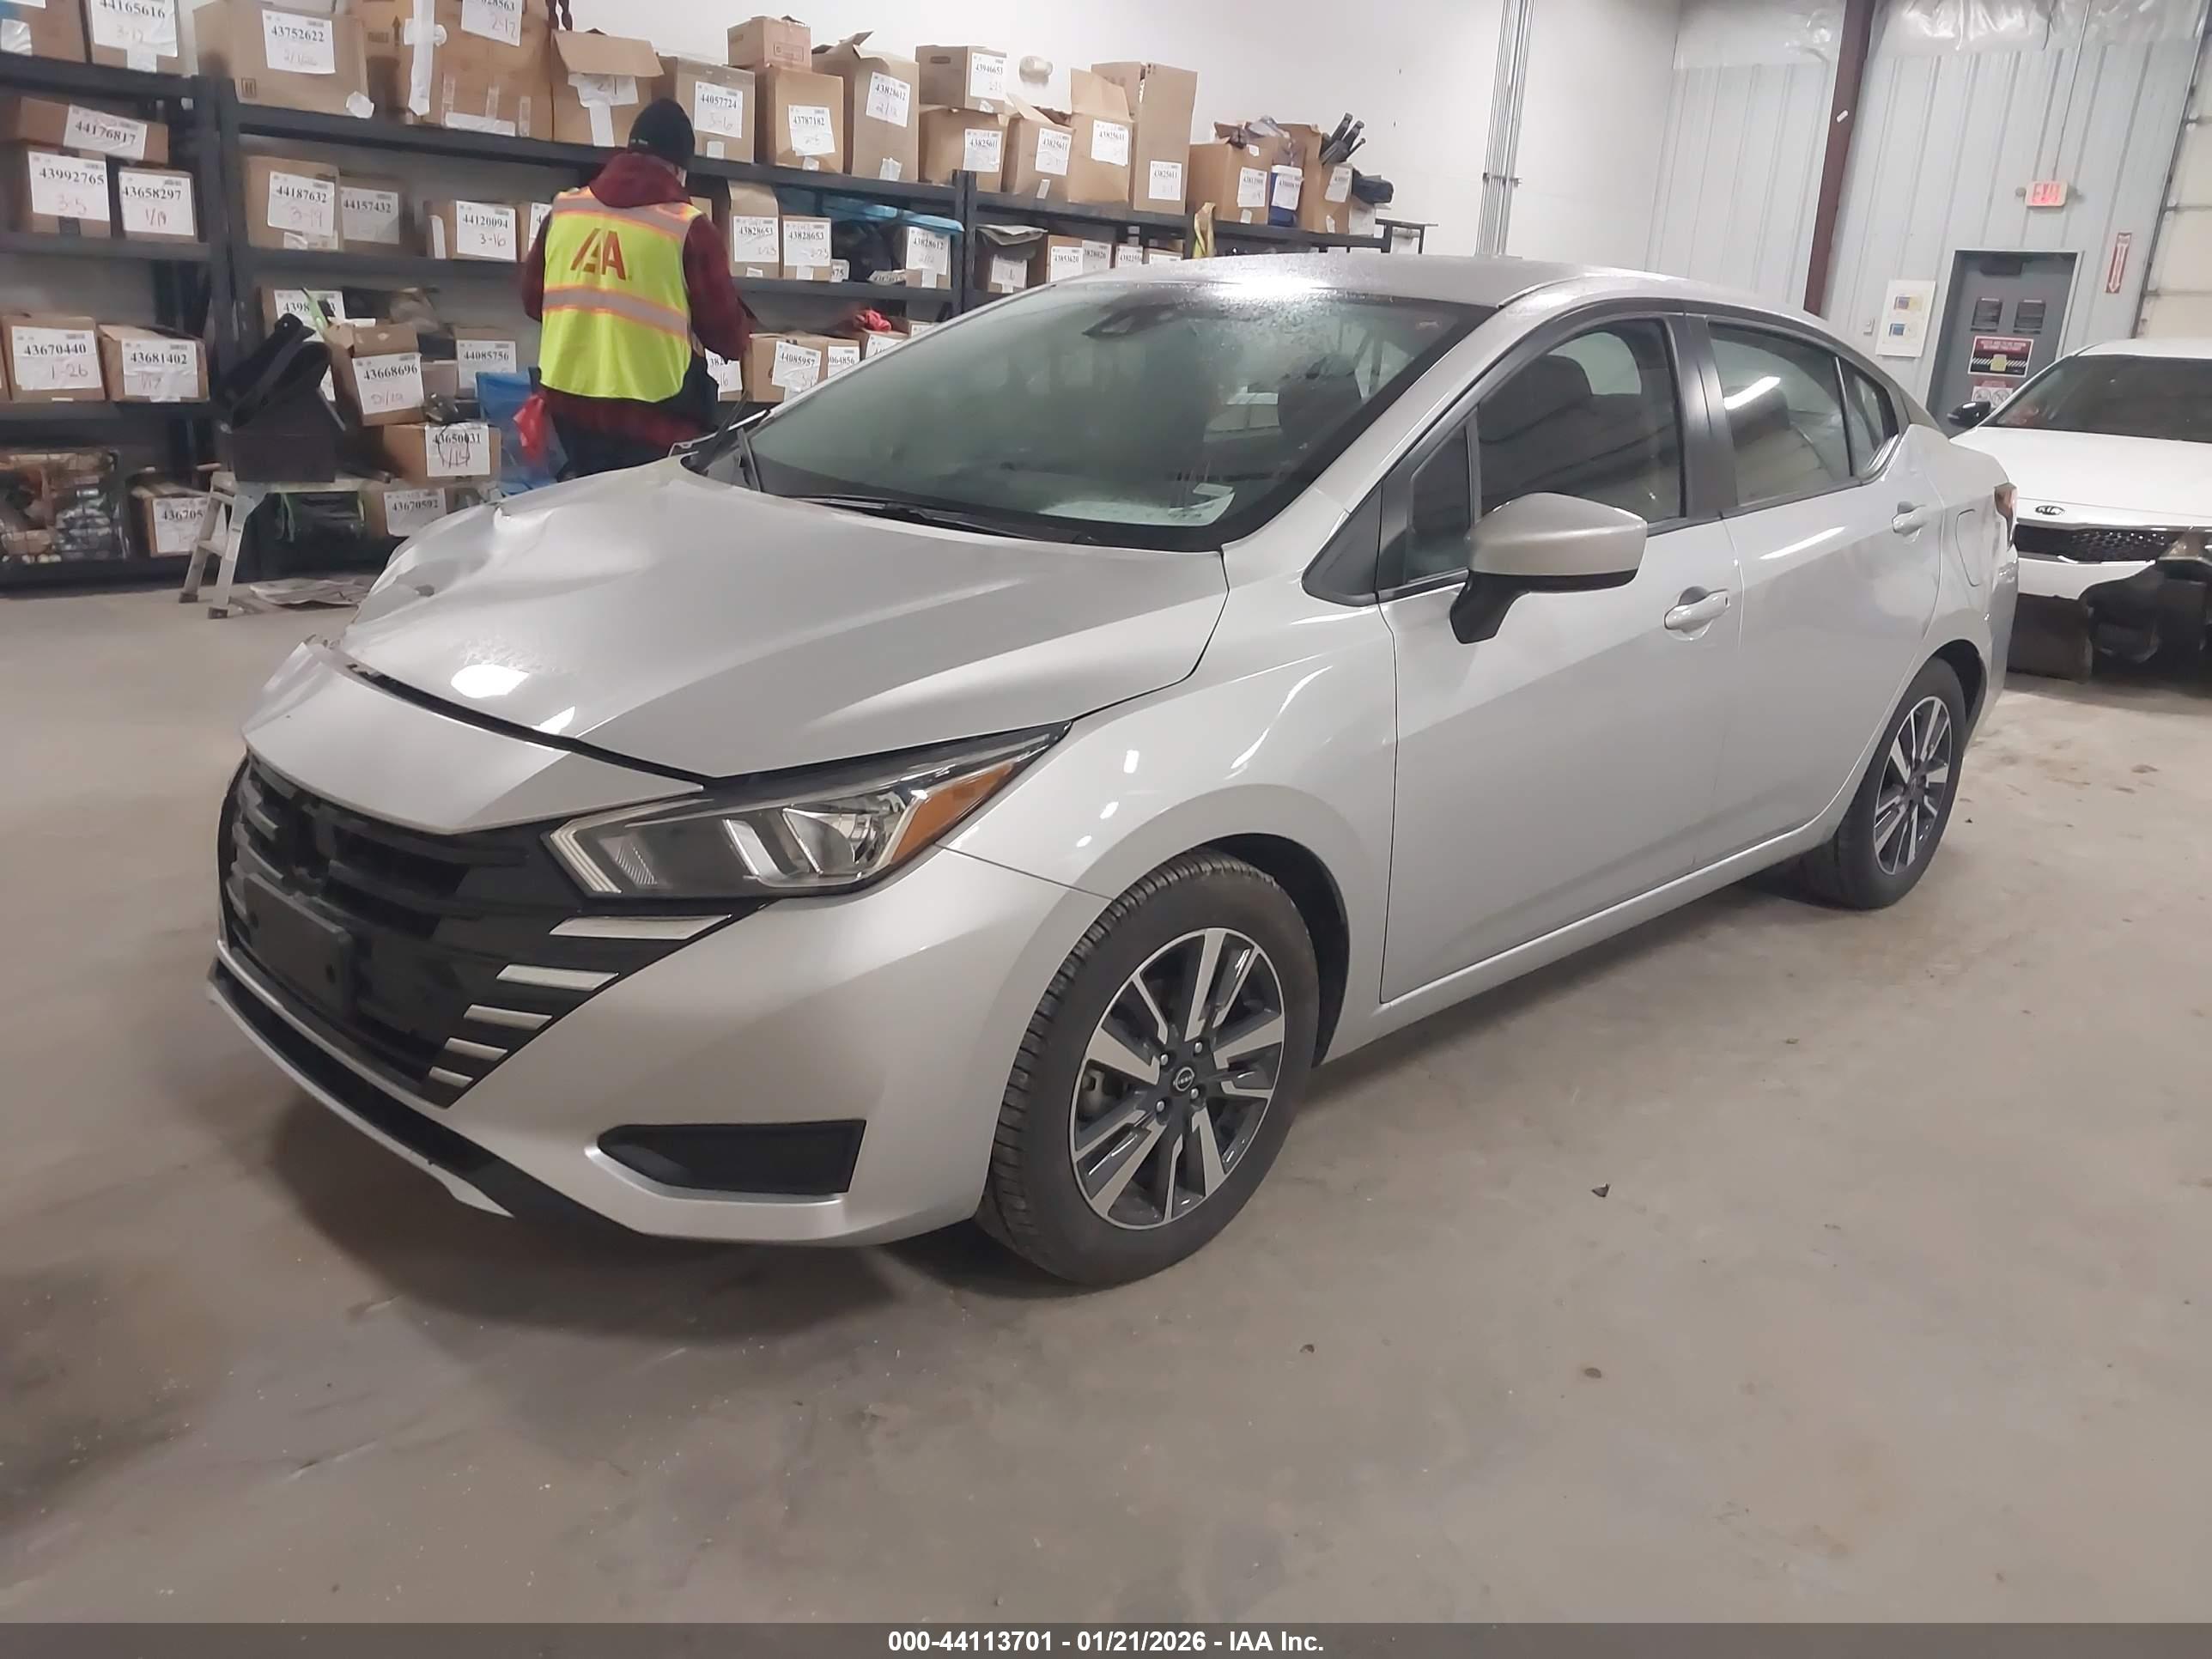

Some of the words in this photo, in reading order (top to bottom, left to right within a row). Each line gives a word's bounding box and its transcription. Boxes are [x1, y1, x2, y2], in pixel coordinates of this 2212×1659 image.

[270, 25, 325, 42] 43752622
[700, 93, 738, 108] 44057724
[76, 121, 137, 145] 44176817
[40, 167, 105, 185] 43992765
[122, 185, 182, 200] 43658297
[276, 185, 328, 204] 44187632
[343, 198, 392, 214] 44157432
[462, 213, 509, 229] 44120094
[283, 302, 337, 313] 43983
[24, 343, 87, 356] 43670440
[463, 350, 510, 362] 44085756
[130, 351, 188, 365] 43681402
[363, 364, 418, 381] 43668696
[163, 509, 204, 521] 436705
